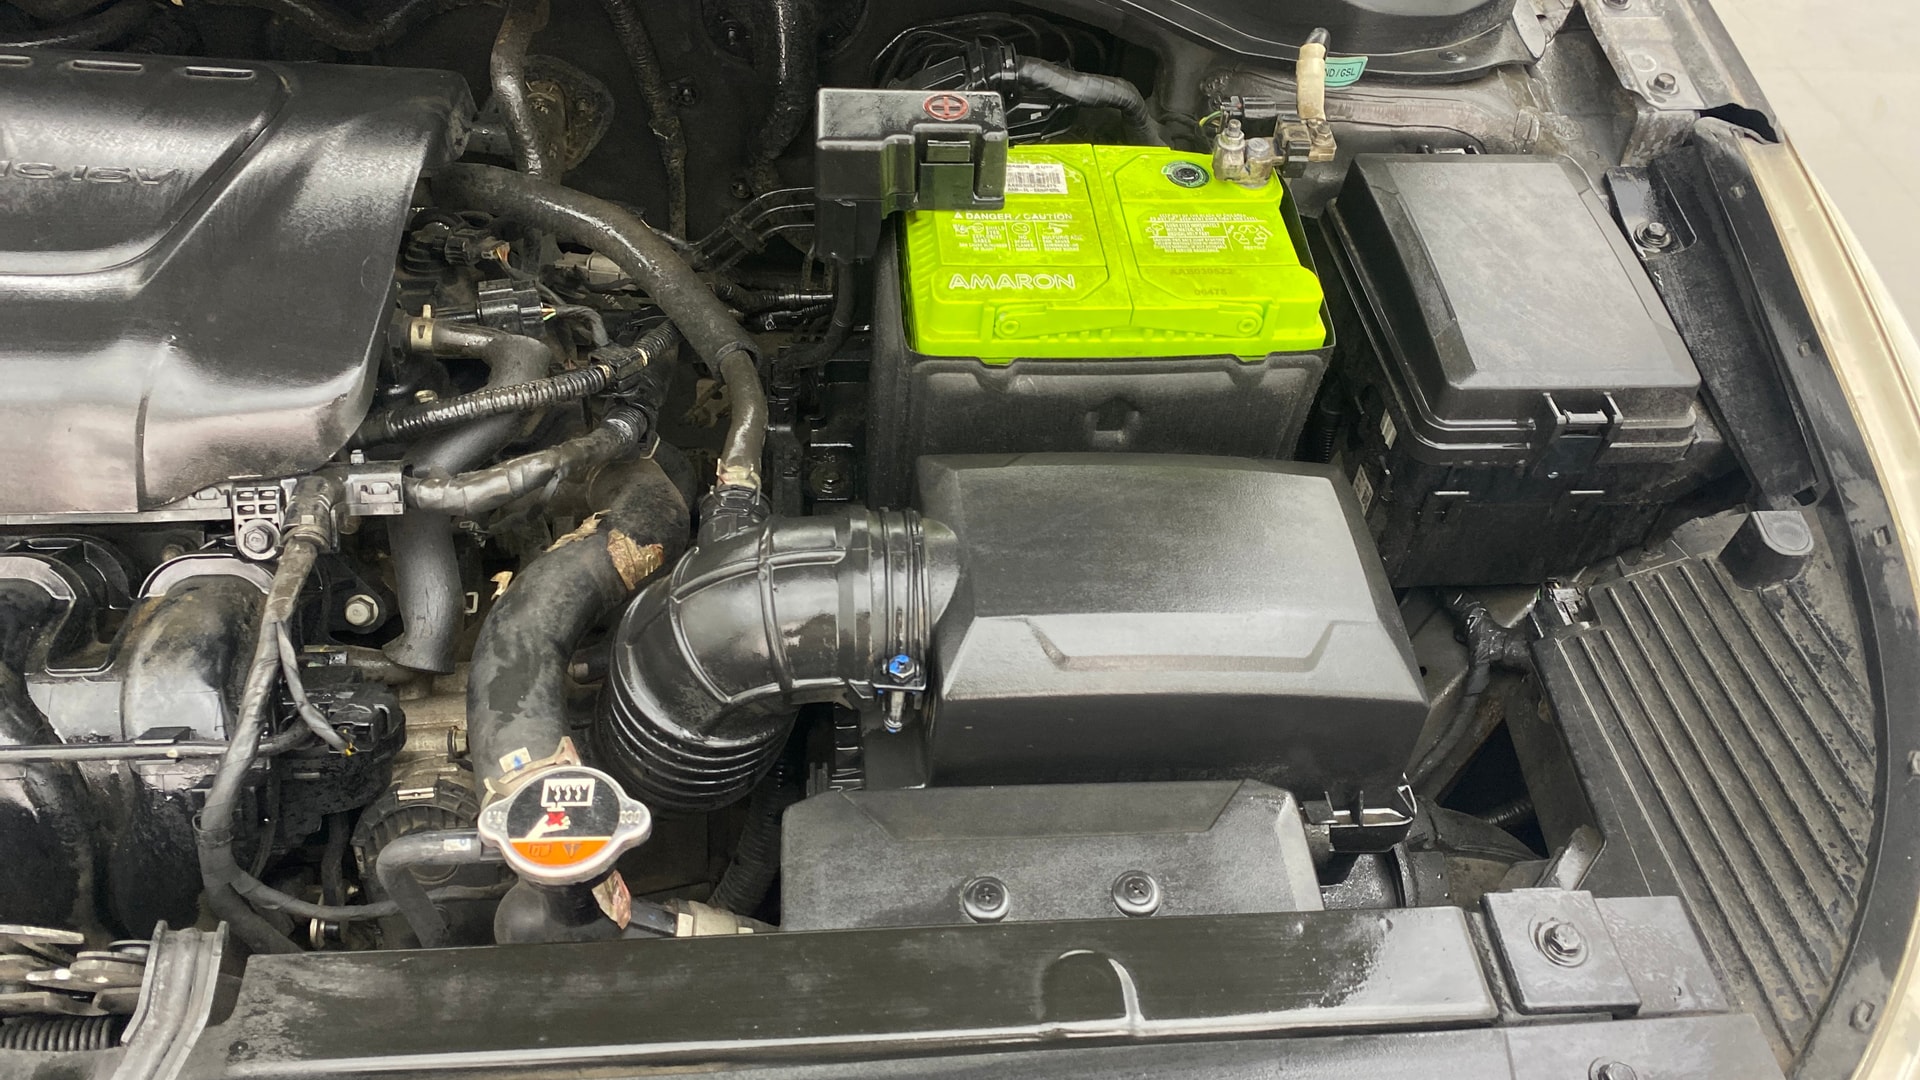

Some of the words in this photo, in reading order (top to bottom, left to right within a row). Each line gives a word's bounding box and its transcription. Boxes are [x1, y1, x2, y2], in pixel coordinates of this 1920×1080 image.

[965, 212, 1011, 220] DANGER
[1023, 212, 1073, 220] CAUTION
[948, 273, 1076, 290] AMARON
